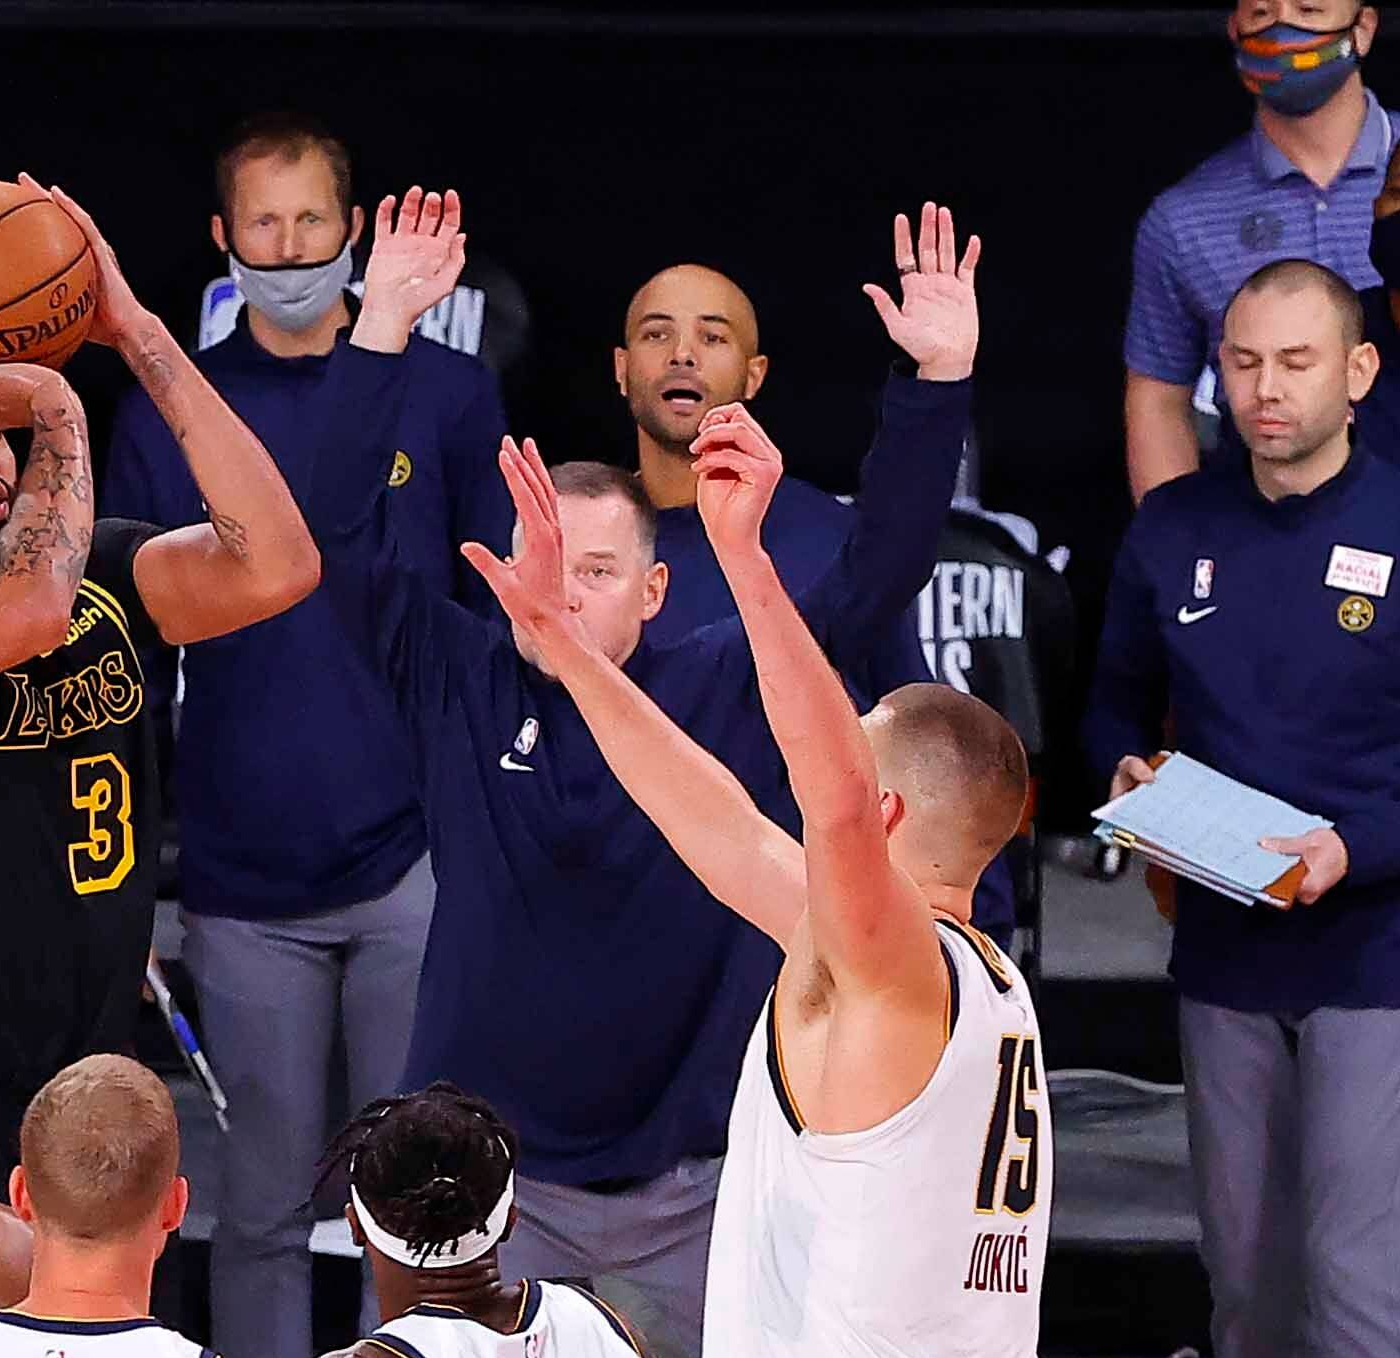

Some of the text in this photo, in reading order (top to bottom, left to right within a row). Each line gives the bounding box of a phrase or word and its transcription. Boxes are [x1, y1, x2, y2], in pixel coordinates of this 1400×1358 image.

[68, 752, 135, 895] 3
[974, 1033, 1039, 1218] 15
[964, 1225, 1028, 1293] JOKIĆ
